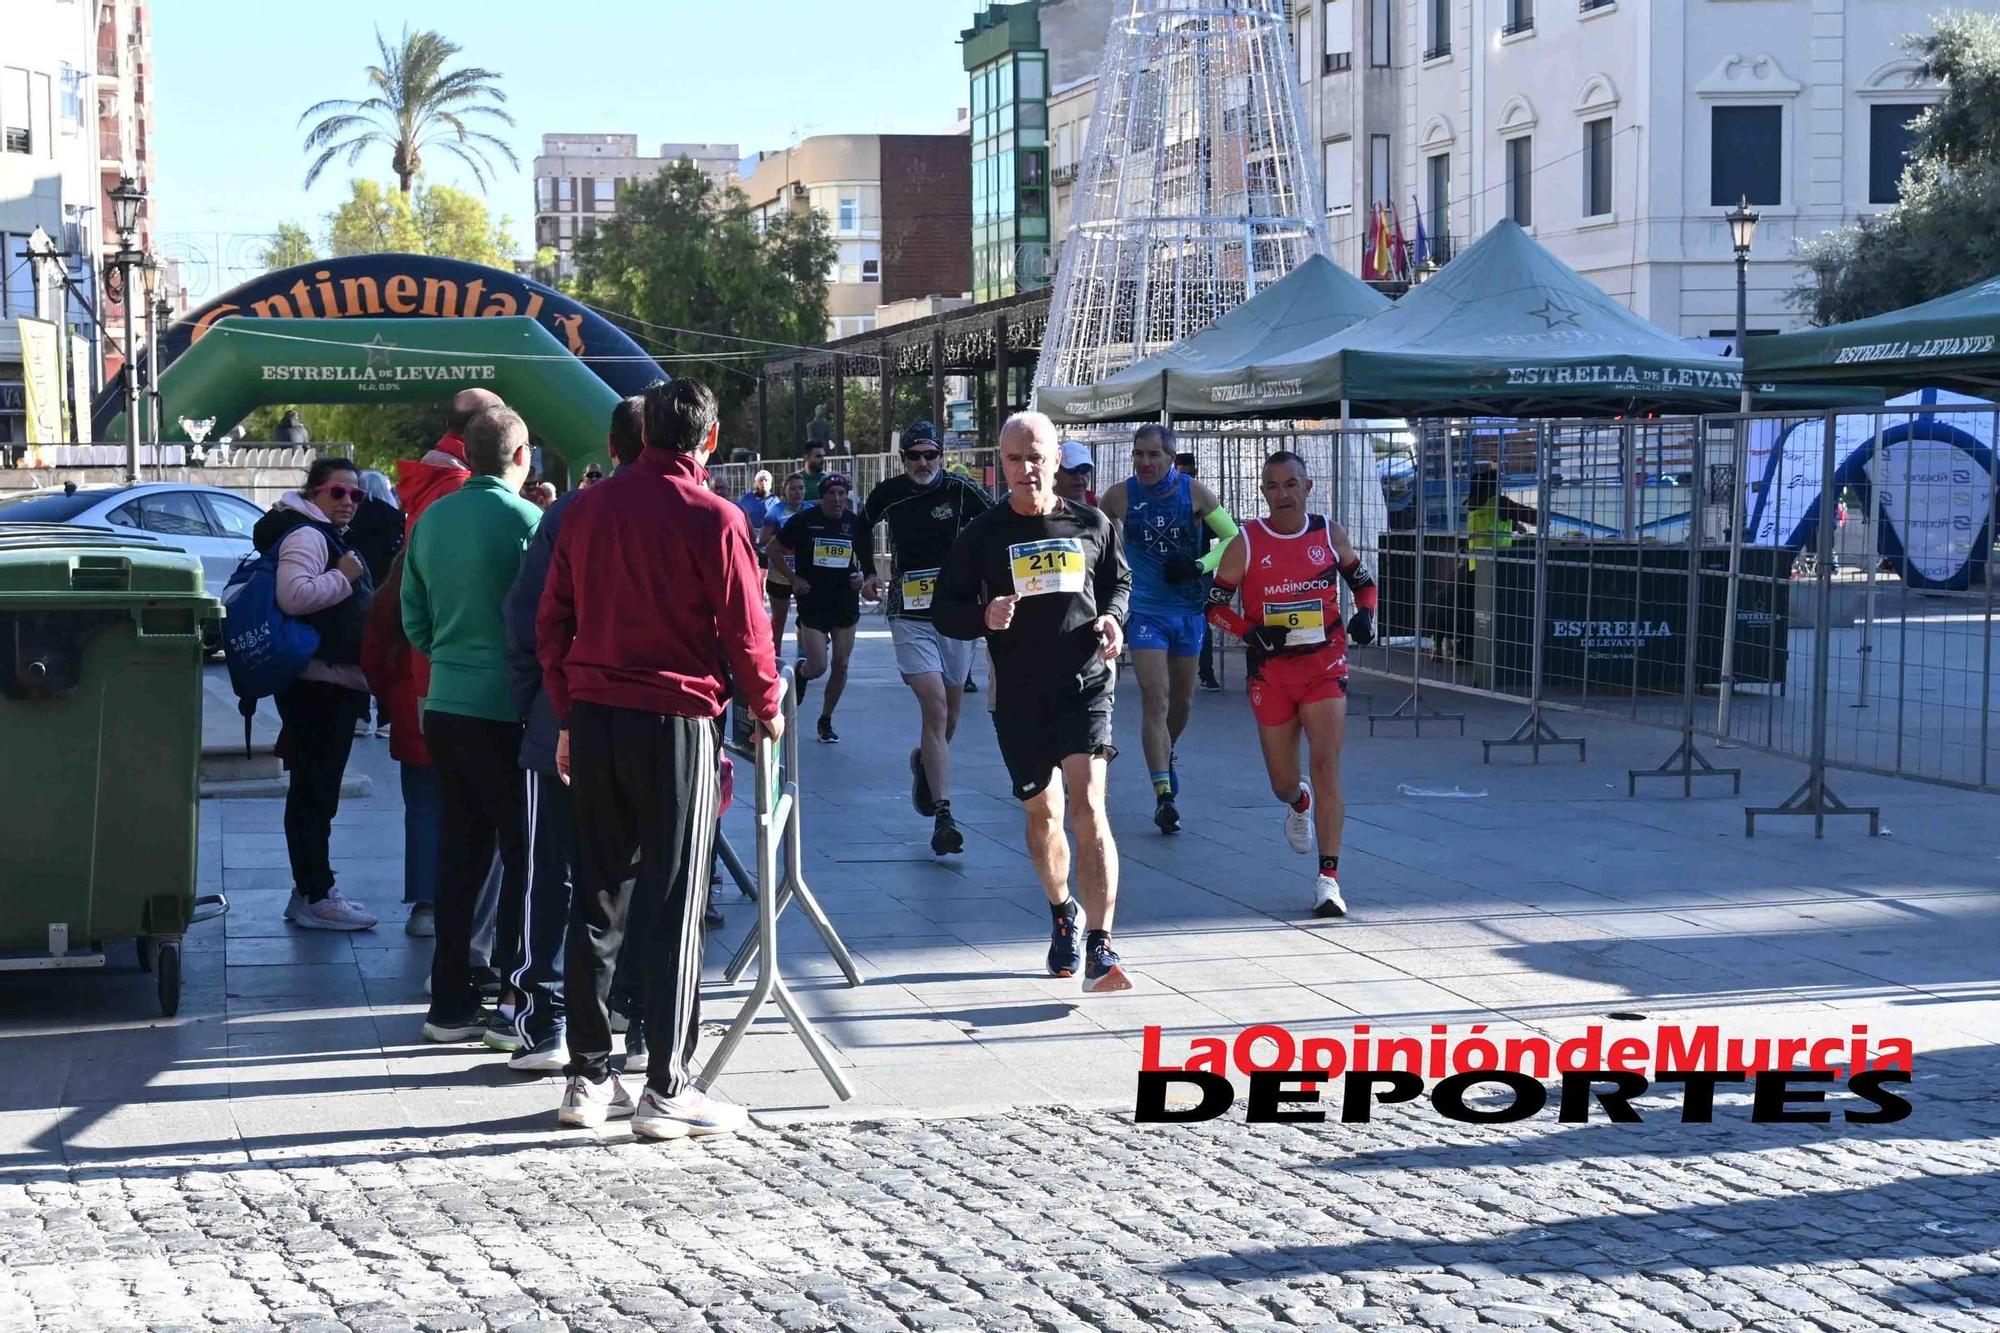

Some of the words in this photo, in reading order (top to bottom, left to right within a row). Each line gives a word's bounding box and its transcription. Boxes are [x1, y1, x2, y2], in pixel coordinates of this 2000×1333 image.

[191, 269, 544, 344] Cntinental
[1835, 341, 1911, 364] ESTRELLA
[1916, 335, 1996, 358] LEVANTE
[261, 366, 377, 380] ESTRELLA
[379, 369, 393, 378] DE
[395, 365, 495, 380] LEVANTE
[1506, 366, 1638, 385] ESTRELLA
[1643, 370, 1660, 380] DE
[1211, 383, 1256, 402] ESTRELLA
[1262, 378, 1303, 398] LEVANTE
[824, 546, 844, 556] 189
[1029, 552, 1067, 570] 211
[1288, 612, 1299, 626] 6
[1552, 621, 1672, 637] ESTRELLA
[1580, 639, 1595, 647] DE
